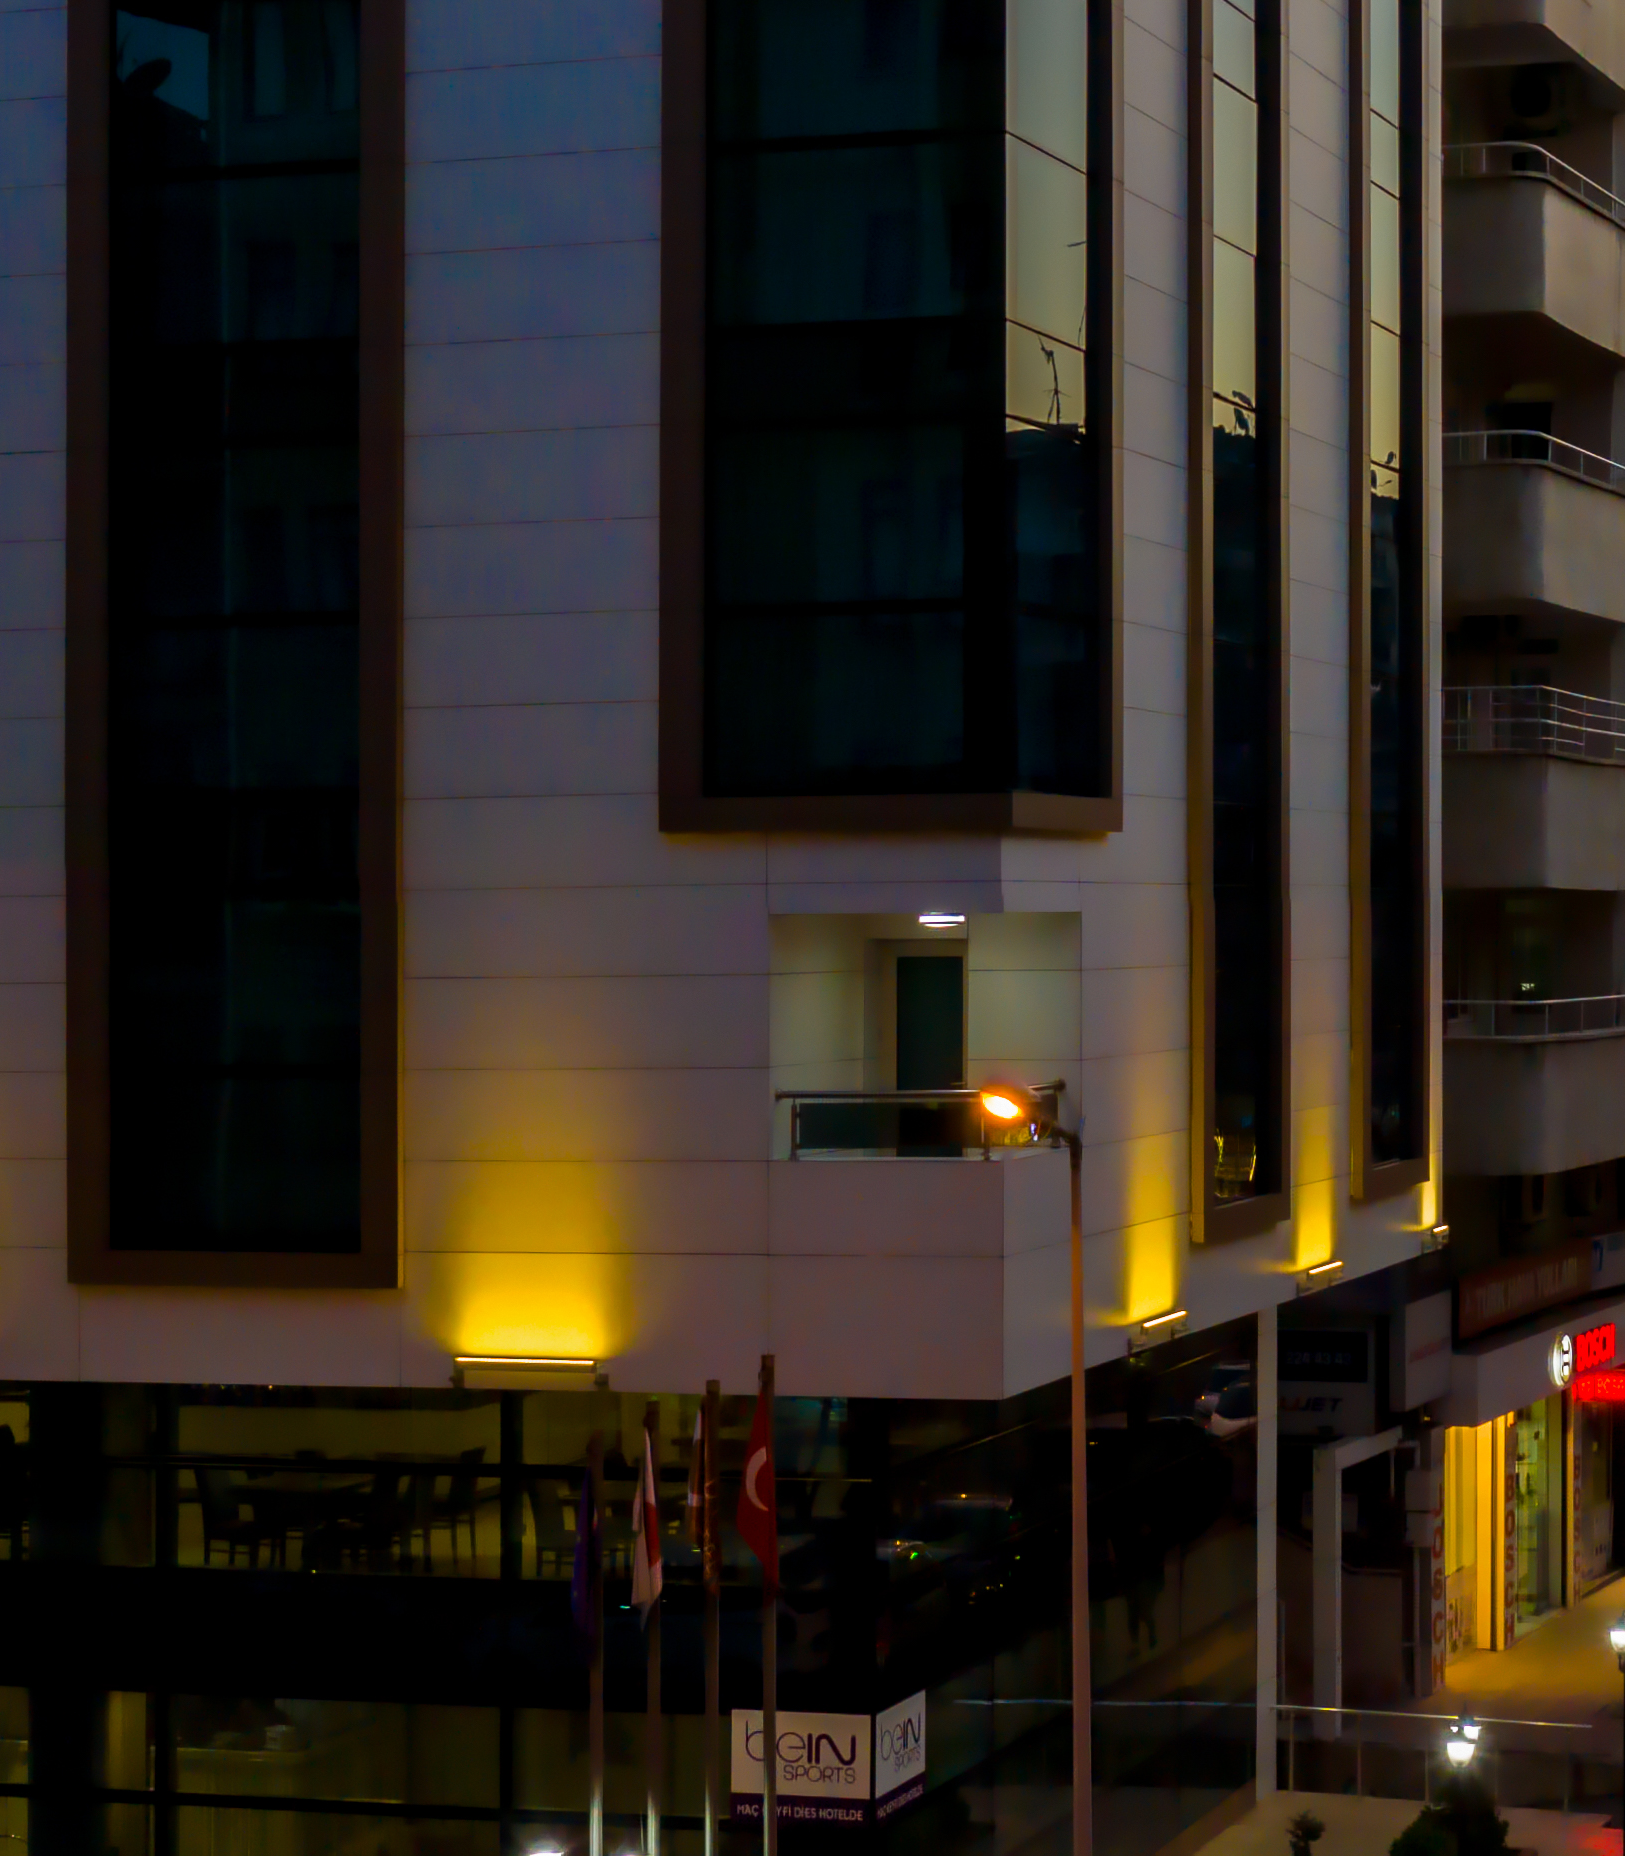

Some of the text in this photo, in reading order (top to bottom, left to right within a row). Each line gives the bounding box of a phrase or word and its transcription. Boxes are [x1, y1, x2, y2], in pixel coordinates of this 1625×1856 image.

[1575, 1322, 1616, 1373] BOSCH
[1504, 1474, 1515, 1646] BOSCH
[783, 1764, 856, 1784] SPORTS
[819, 1807, 864, 1822] HOTELDE
